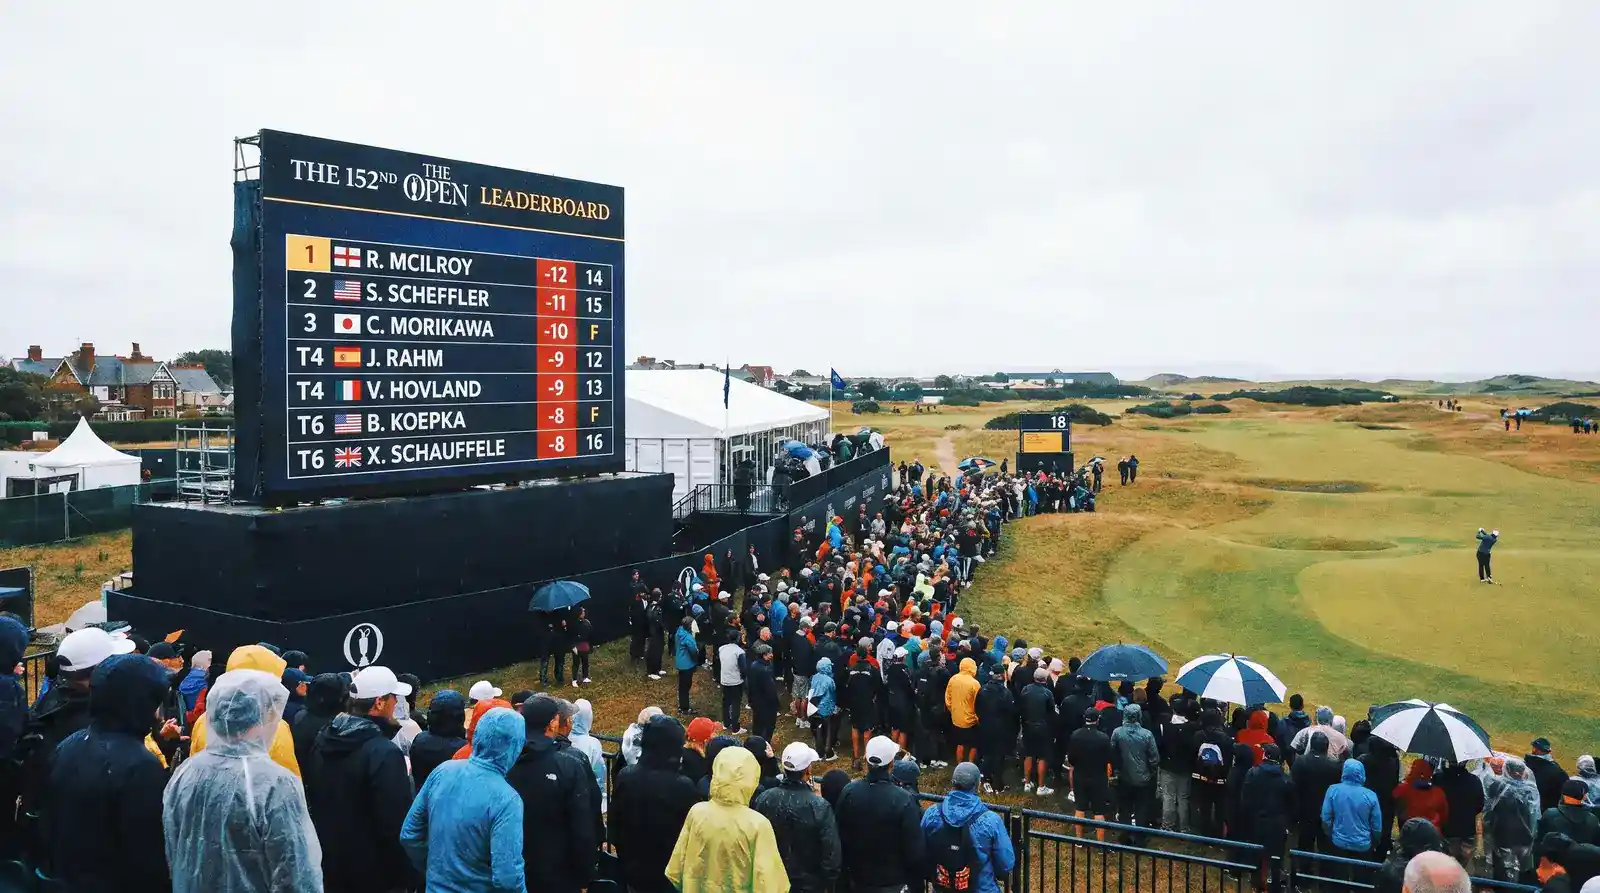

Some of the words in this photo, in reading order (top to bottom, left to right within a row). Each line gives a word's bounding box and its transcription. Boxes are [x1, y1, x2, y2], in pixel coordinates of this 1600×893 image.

[290, 159, 340, 185] THE
[346, 167, 398, 190] 152ND
[422, 163, 451, 181] THE
[403, 173, 469, 207] OPEN
[480, 186, 610, 221] LEADERBOARD
[305, 245, 314, 264] 1
[366, 250, 384, 270] R.
[390, 254, 473, 276] MCILROY
[545, 267, 568, 284] -12
[586, 270, 603, 287] 14
[303, 279, 317, 298] 2
[366, 283, 382, 302] S.
[388, 284, 489, 307] SCHEFFLER
[545, 295, 566, 311] -11
[586, 297, 603, 313] 15
[303, 313, 317, 332] 3
[366, 316, 384, 335] C.
[391, 317, 494, 338] MORIKAWA
[544, 323, 568, 340] -10
[591, 324, 599, 340] F
[297, 347, 325, 367] T4
[366, 349, 381, 368] J.
[387, 349, 443, 367] RAHM
[548, 351, 564, 367] -9
[586, 352, 603, 368] 12
[297, 381, 325, 400] T4
[366, 381, 382, 399] V.
[390, 380, 482, 399] HOVLAND
[548, 379, 564, 396] -9
[586, 380, 603, 396] 13
[297, 415, 325, 434] T6
[367, 413, 384, 432] B.
[391, 410, 466, 431] KOEPKA
[548, 407, 565, 424] -8
[591, 406, 599, 423] F
[1051, 415, 1066, 429] 18
[297, 449, 325, 469] T6
[367, 445, 385, 465] X.
[391, 438, 506, 463] SCHAUFFELE
[548, 435, 565, 452] -8
[586, 434, 603, 450] 16
